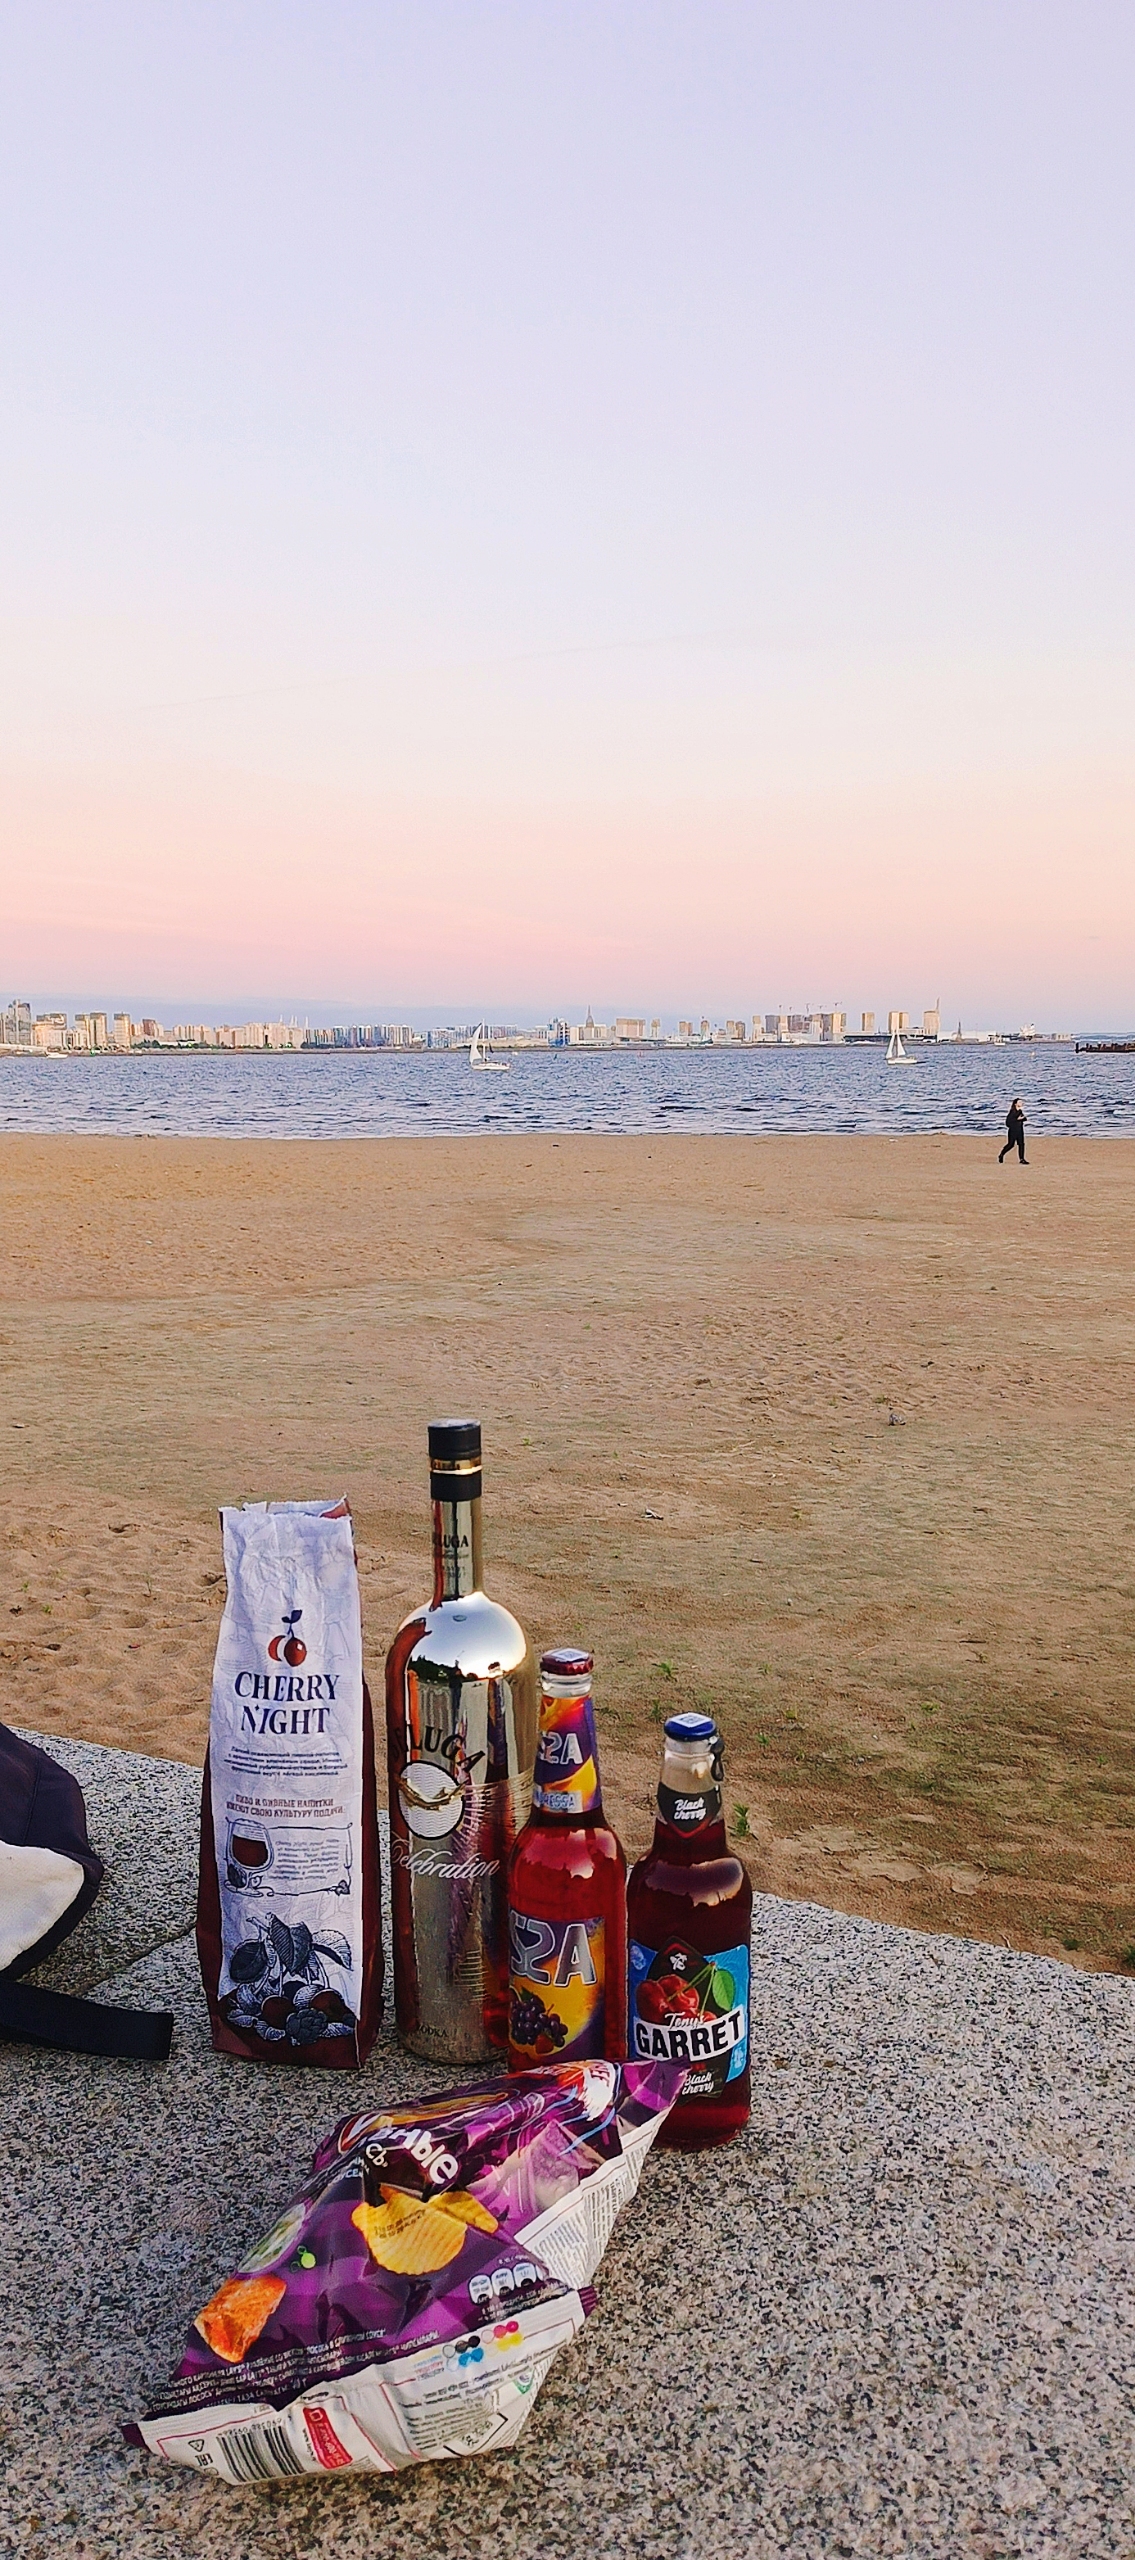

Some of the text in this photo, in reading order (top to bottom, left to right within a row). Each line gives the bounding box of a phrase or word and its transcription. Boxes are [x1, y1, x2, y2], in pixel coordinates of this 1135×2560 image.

[234, 1670, 341, 1702] CHERRY
[241, 1704, 331, 1735] NIGHT
[297, 1798, 334, 1808] НАПИТКИ
[674, 1797, 704, 1811] Black
[273, 1809, 313, 1818] КУЛЬТУРУ
[674, 1807, 707, 1821] cherry
[636, 2010, 741, 2060] GARRET
[682, 2080, 715, 2096] cherry
